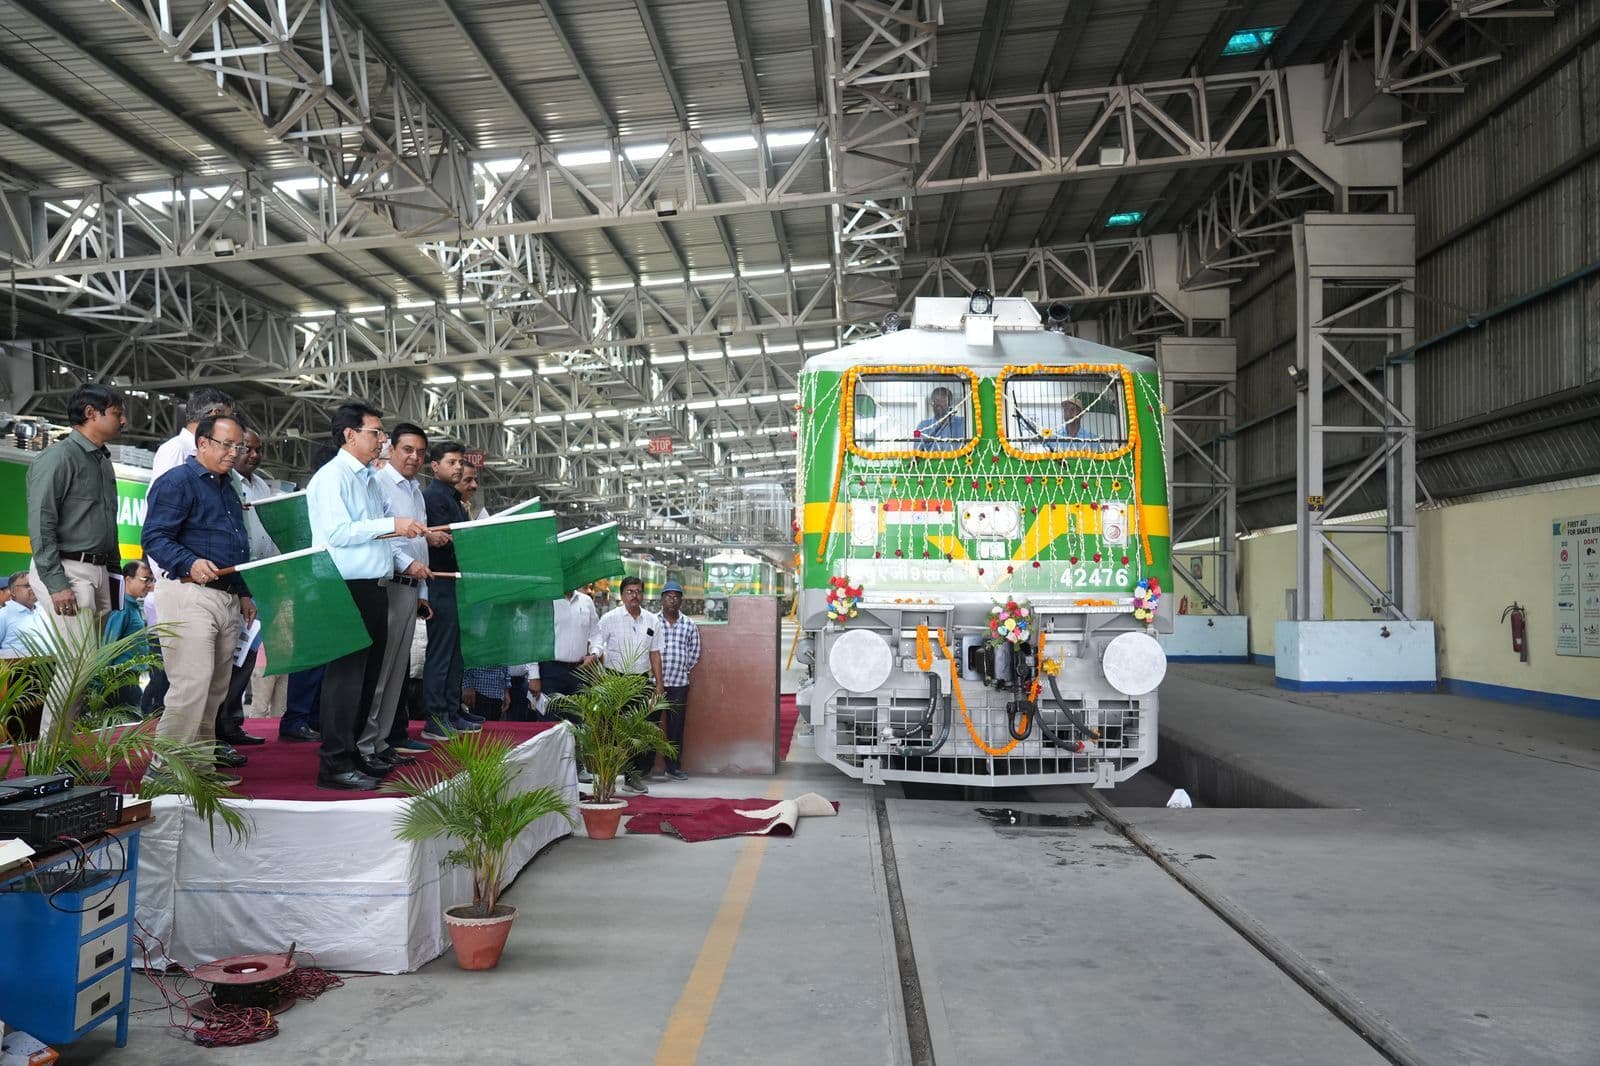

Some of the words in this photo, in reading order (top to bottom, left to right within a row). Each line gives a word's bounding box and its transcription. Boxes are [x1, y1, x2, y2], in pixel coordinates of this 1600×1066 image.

[649, 439, 670, 451] STOP
[463, 453, 483, 465] STOP
[1568, 520, 1579, 528] FIRST
[1568, 528, 1576, 536] FOR
[1060, 568, 1128, 587] 42476
